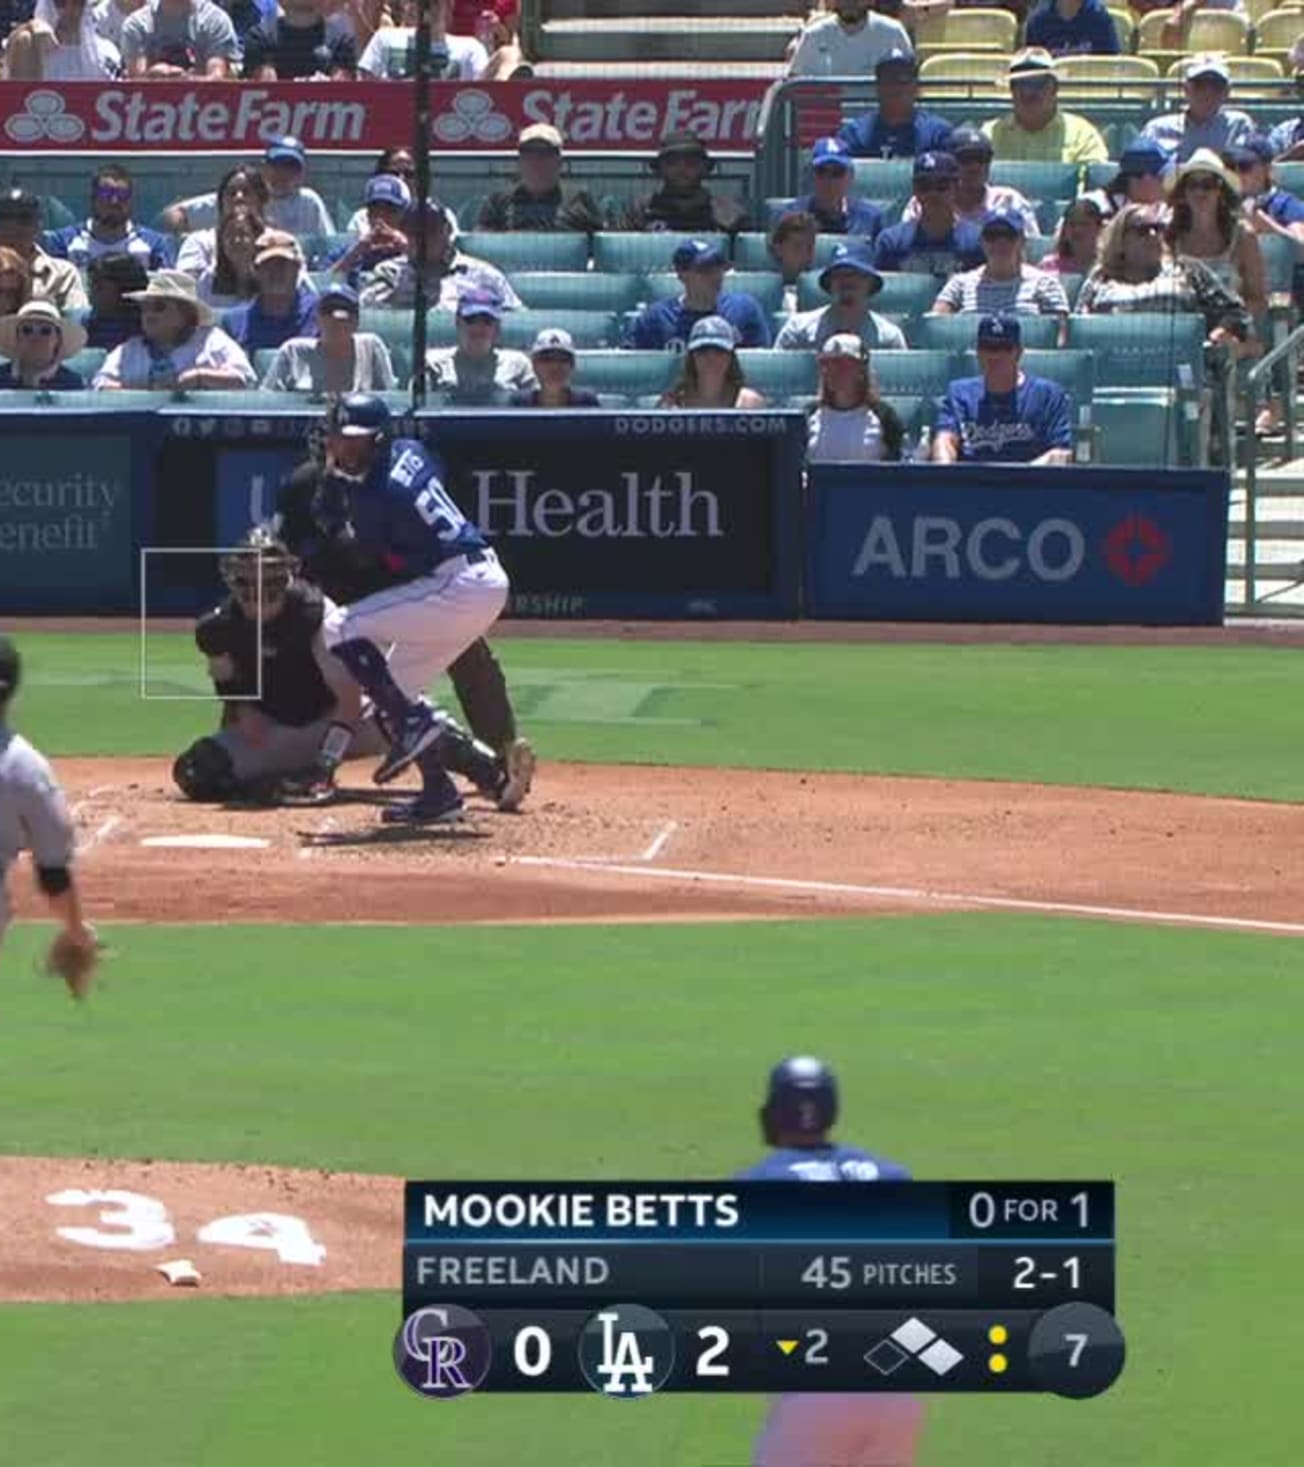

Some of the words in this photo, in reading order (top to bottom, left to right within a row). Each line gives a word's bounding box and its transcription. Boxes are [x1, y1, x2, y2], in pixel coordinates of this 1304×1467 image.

[615, 416, 787, 433] DODGERS.COM
[414, 477, 466, 541] 50
[472, 469, 724, 538] Health
[853, 515, 1086, 582] ARCO
